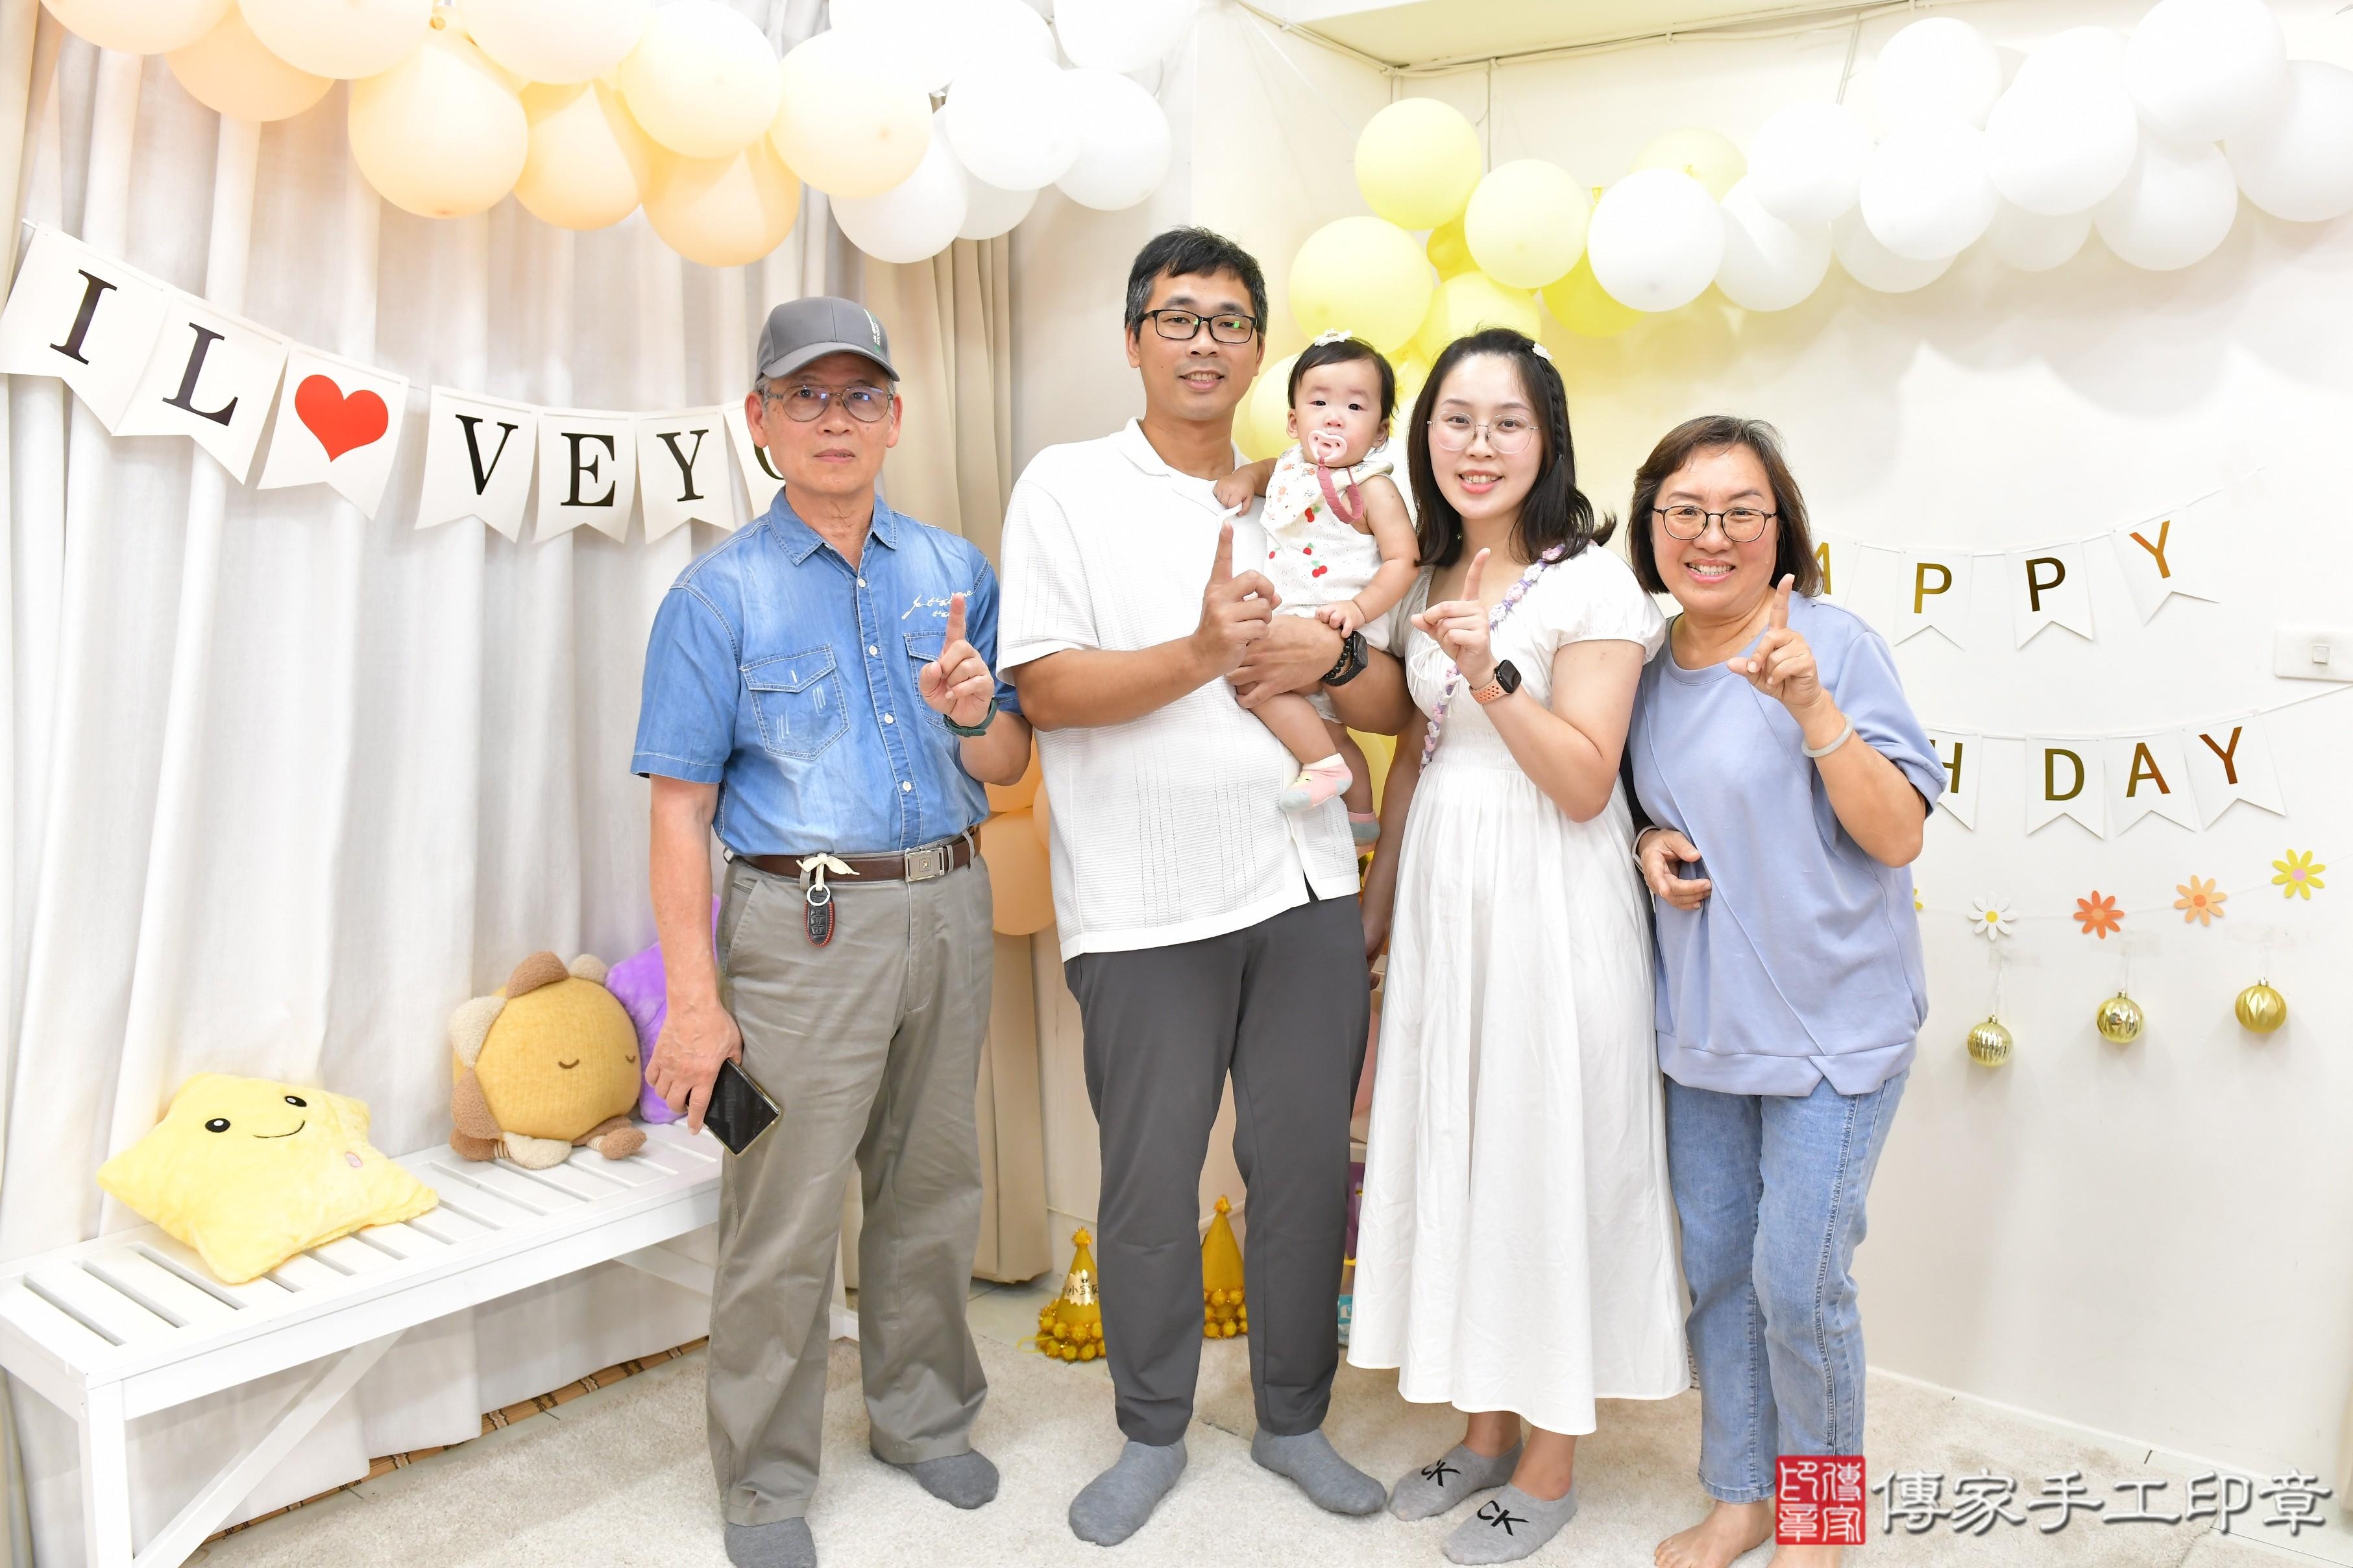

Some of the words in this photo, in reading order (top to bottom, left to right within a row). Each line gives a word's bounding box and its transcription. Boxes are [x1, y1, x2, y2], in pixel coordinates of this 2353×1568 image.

[50, 269, 117, 365] I
[1929, 739, 1963, 793] H
[2043, 726, 2243, 802] DAY
[1421, 1458, 1461, 1488] CK
[1477, 1499, 1530, 1537] CK
